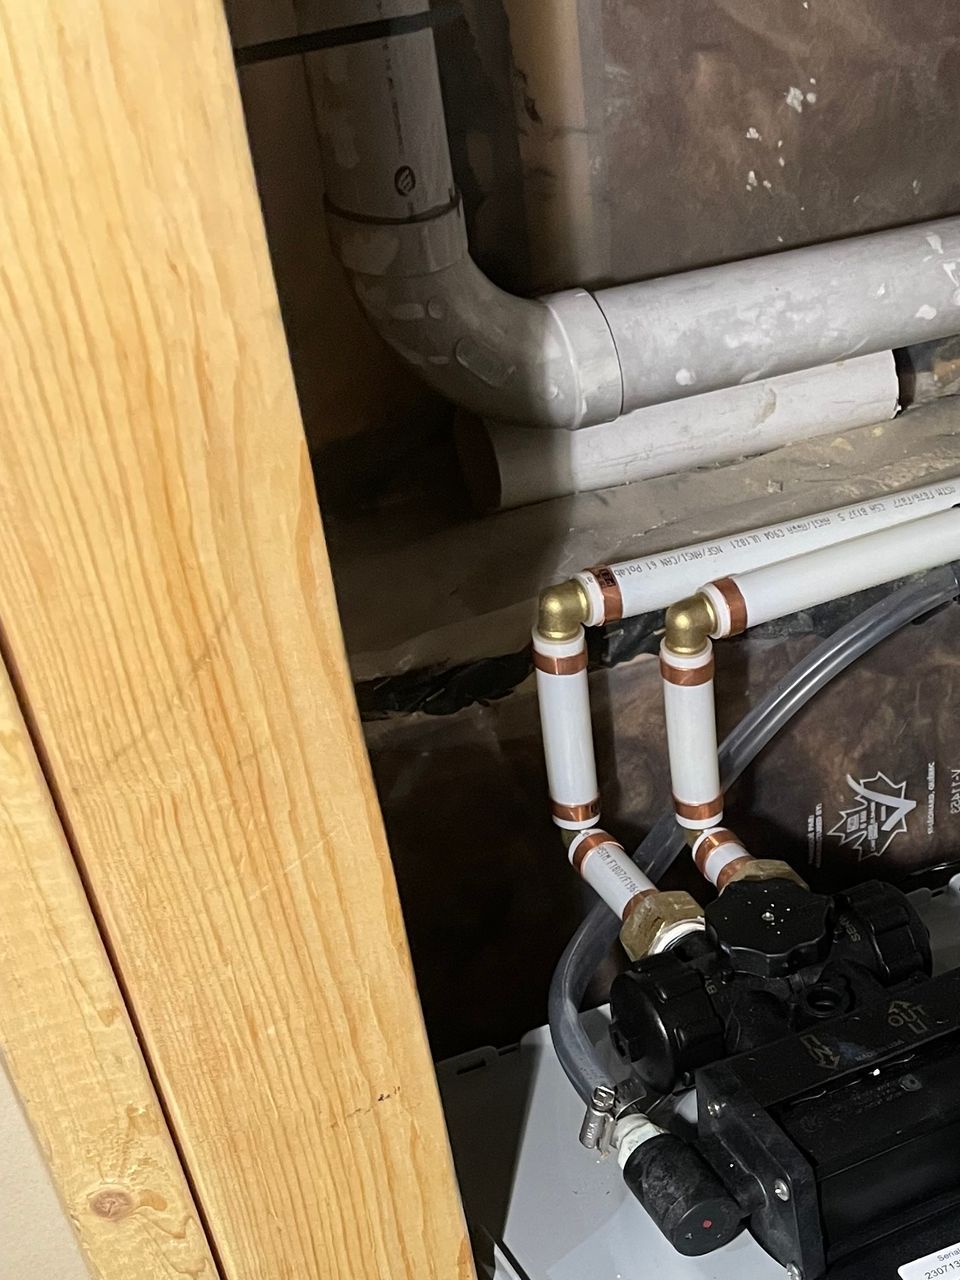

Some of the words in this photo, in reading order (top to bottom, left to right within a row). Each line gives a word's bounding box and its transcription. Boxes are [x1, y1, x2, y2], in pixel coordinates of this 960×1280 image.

[613, 562, 642, 581] Potab
[645, 560, 657, 570] 61
[888, 1004, 927, 1028] OUT
